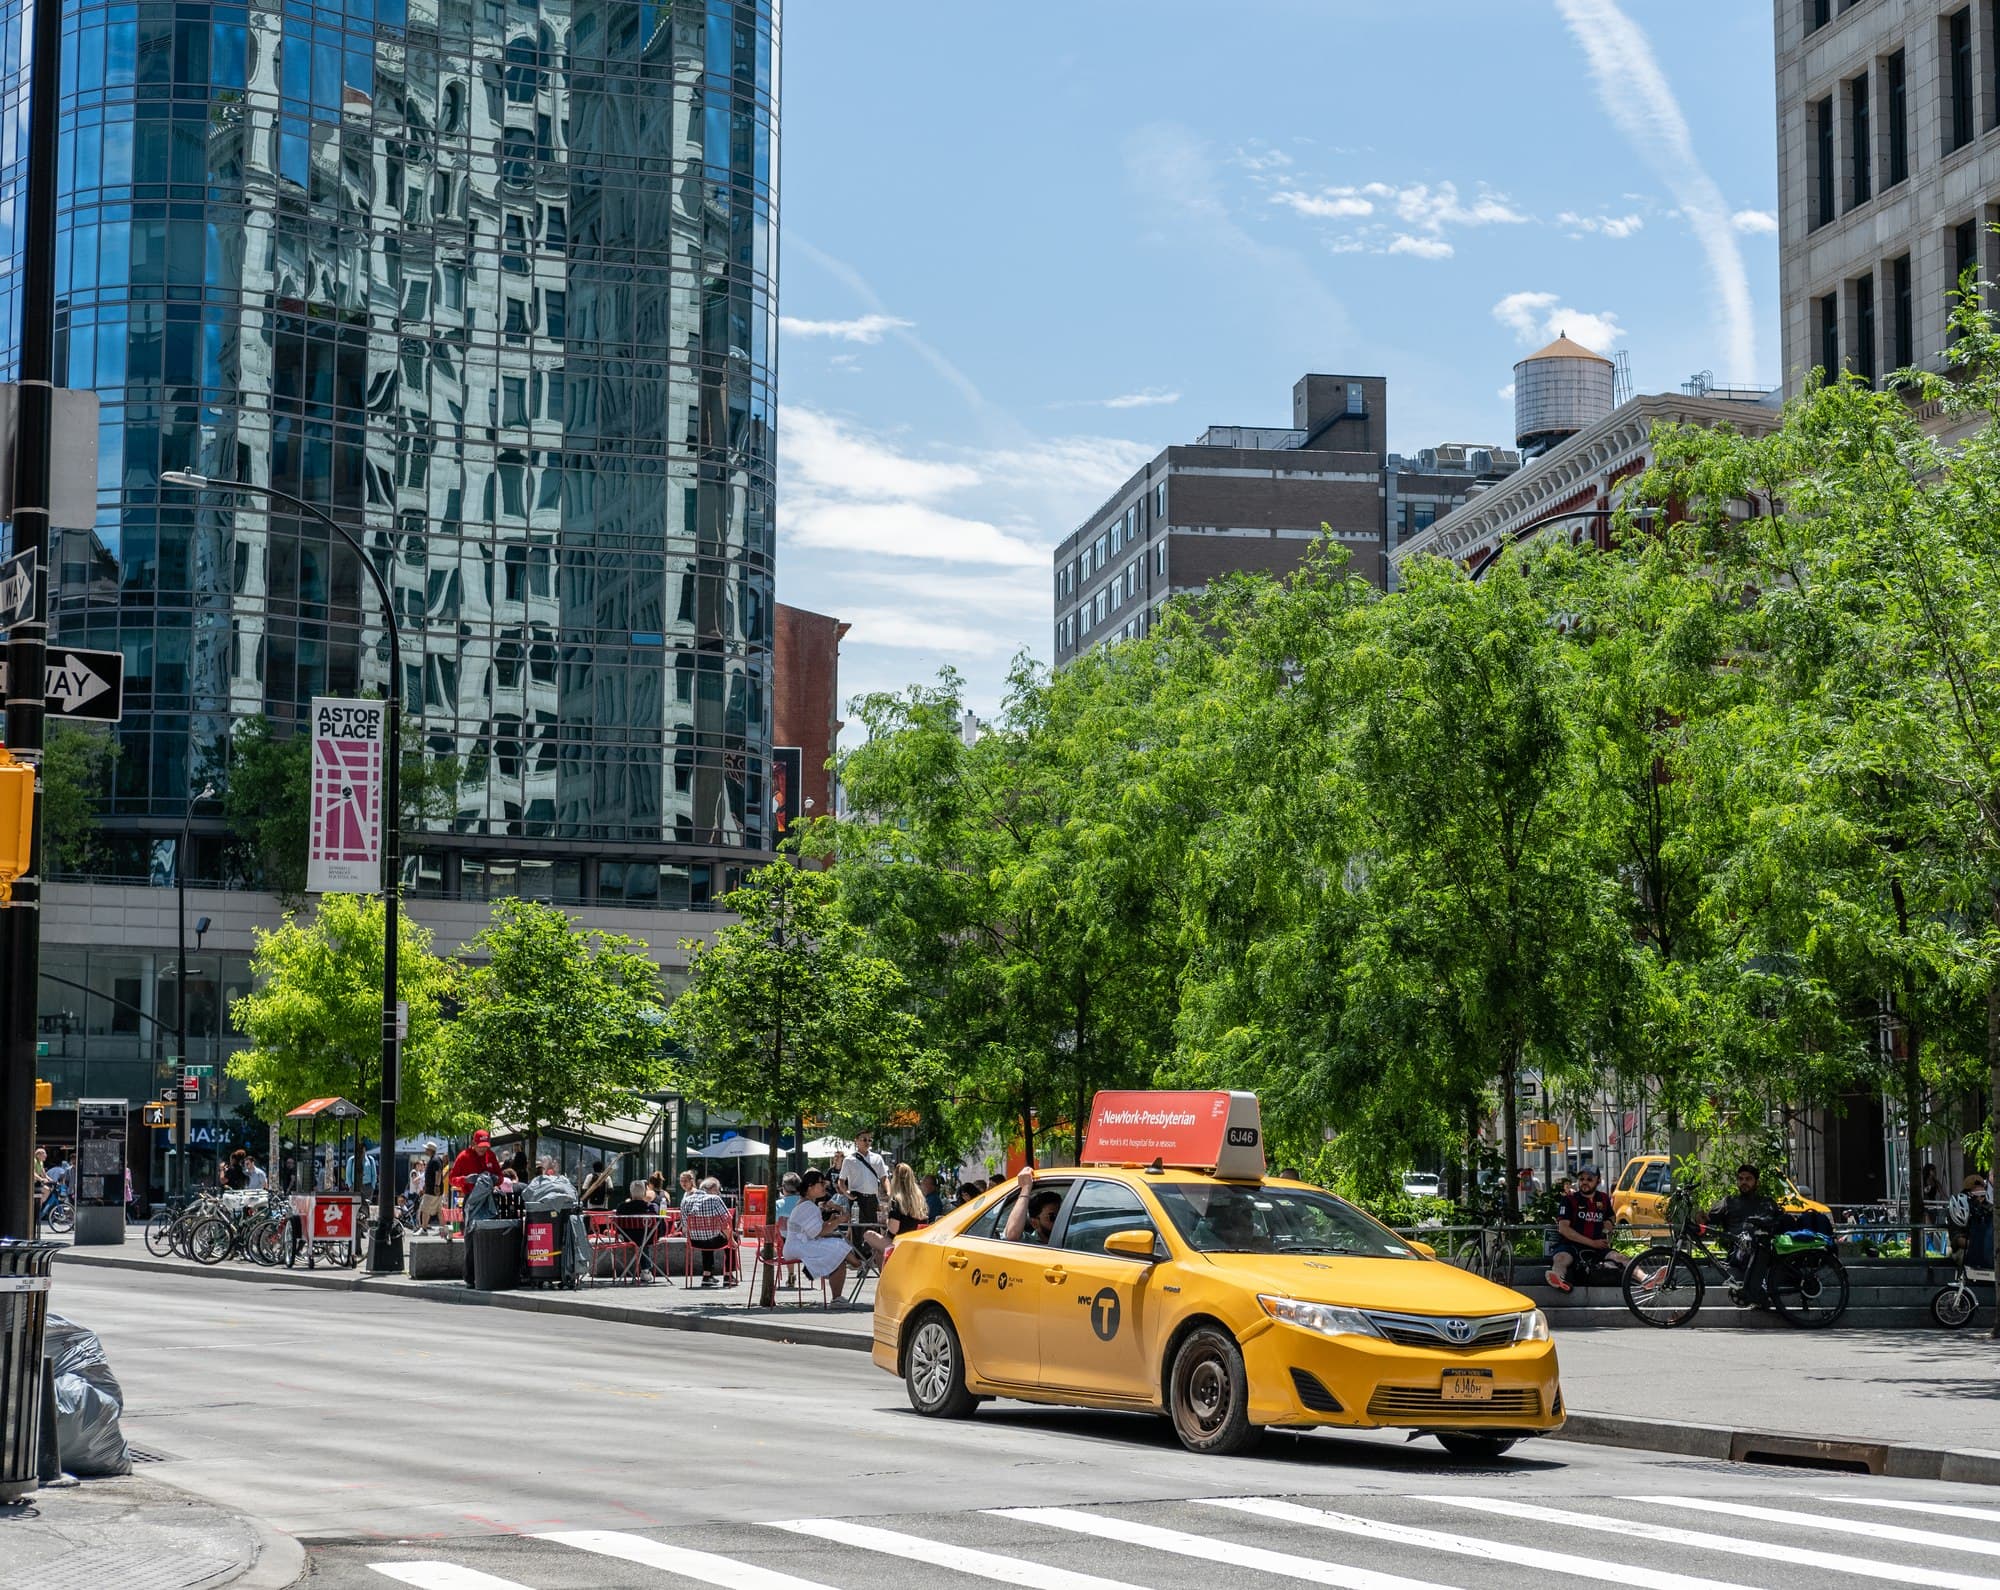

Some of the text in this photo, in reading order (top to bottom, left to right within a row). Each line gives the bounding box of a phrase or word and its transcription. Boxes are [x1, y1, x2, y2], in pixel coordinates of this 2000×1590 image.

[5, 575, 26, 607] WAY
[318, 706, 380, 724] ASTOR
[319, 722, 377, 739] PLACE
[1103, 1109, 1196, 1129] NewYork-Presbyterian
[1230, 1130, 1254, 1143] 6J46
[1578, 1211, 1604, 1221] QATAR
[1077, 1295, 1092, 1306] NYC
